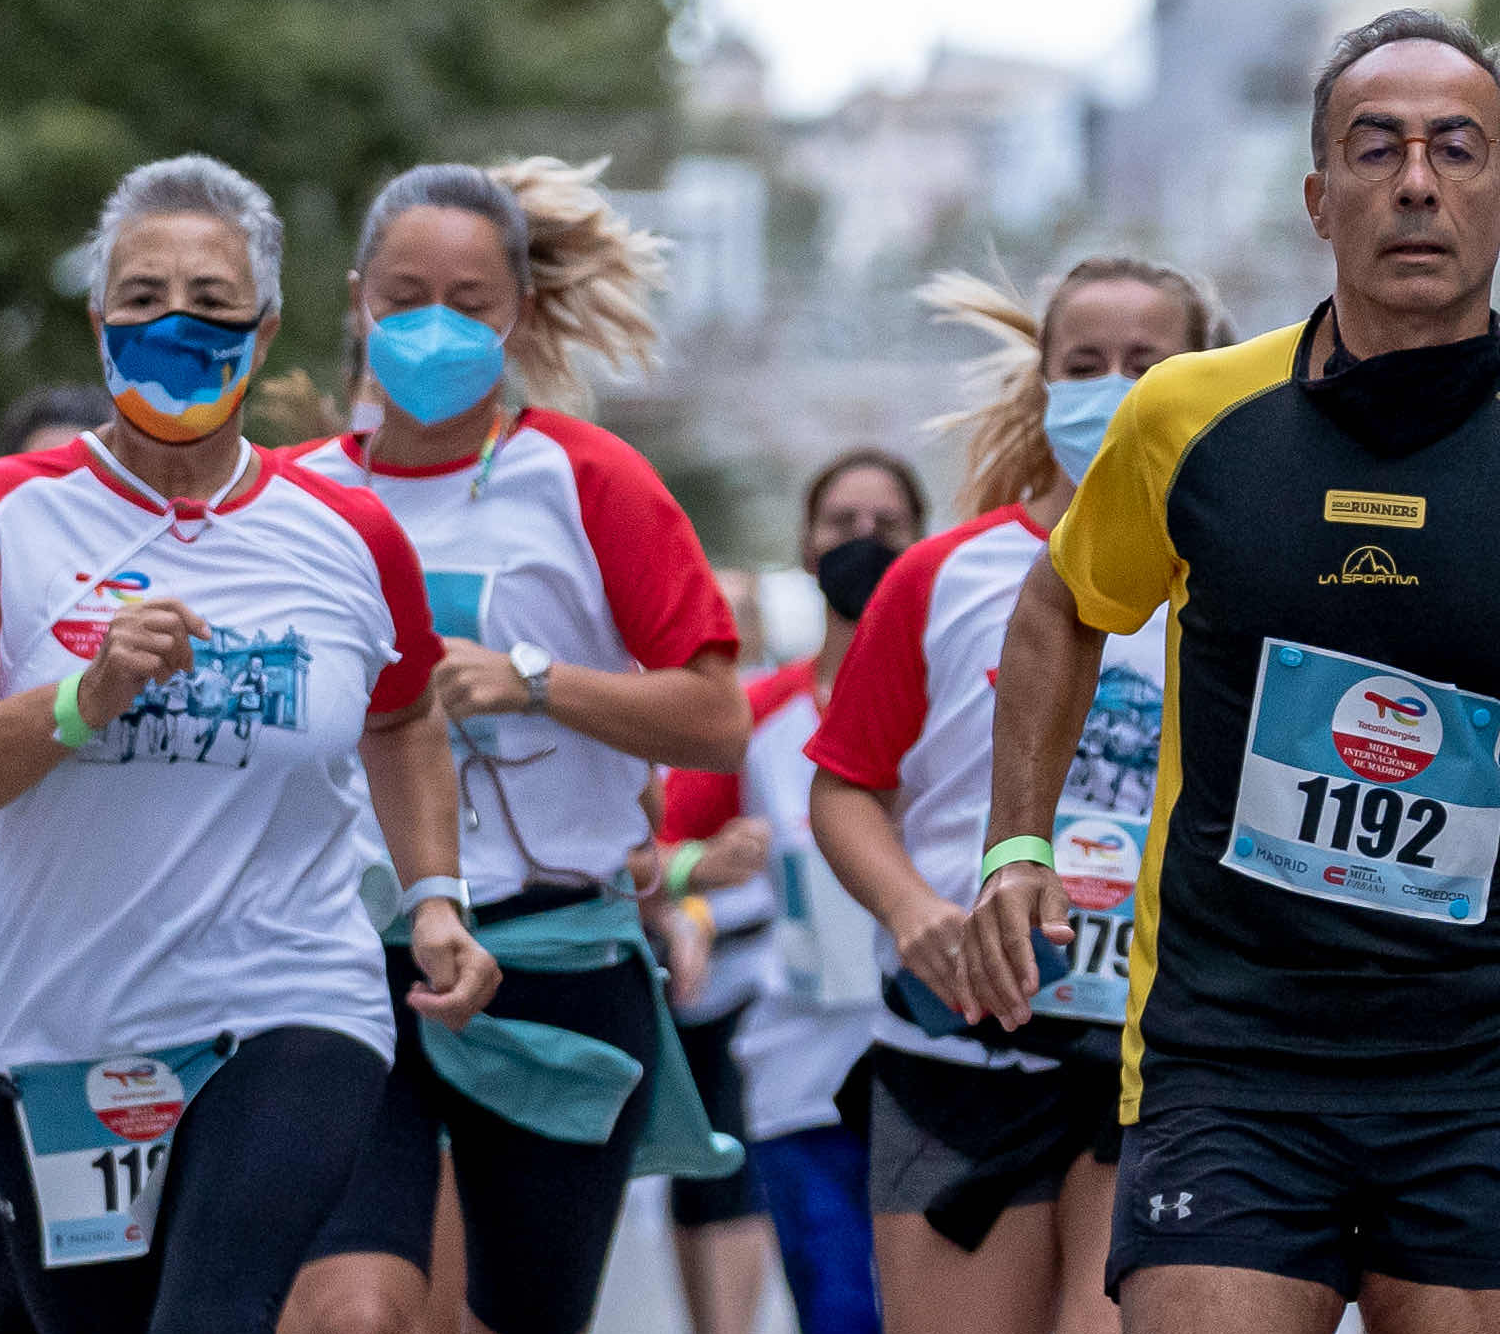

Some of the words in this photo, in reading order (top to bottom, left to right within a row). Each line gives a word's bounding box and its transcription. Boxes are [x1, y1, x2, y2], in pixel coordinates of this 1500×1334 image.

[1351, 501, 1418, 518] RUNNERS
[1318, 574, 1338, 584] LA
[1341, 574, 1419, 585] SPORTIVA
[1357, 720, 1421, 742] TotalEnergies
[1343, 747, 1418, 771] INTERNACIONAL
[1368, 742, 1398, 757] MILLA
[1352, 759, 1366, 768] DE
[1368, 761, 1406, 778] MADRID
[1297, 775, 1448, 869] 1192
[1255, 847, 1309, 874] MADRID
[1349, 869, 1383, 884] MILLA
